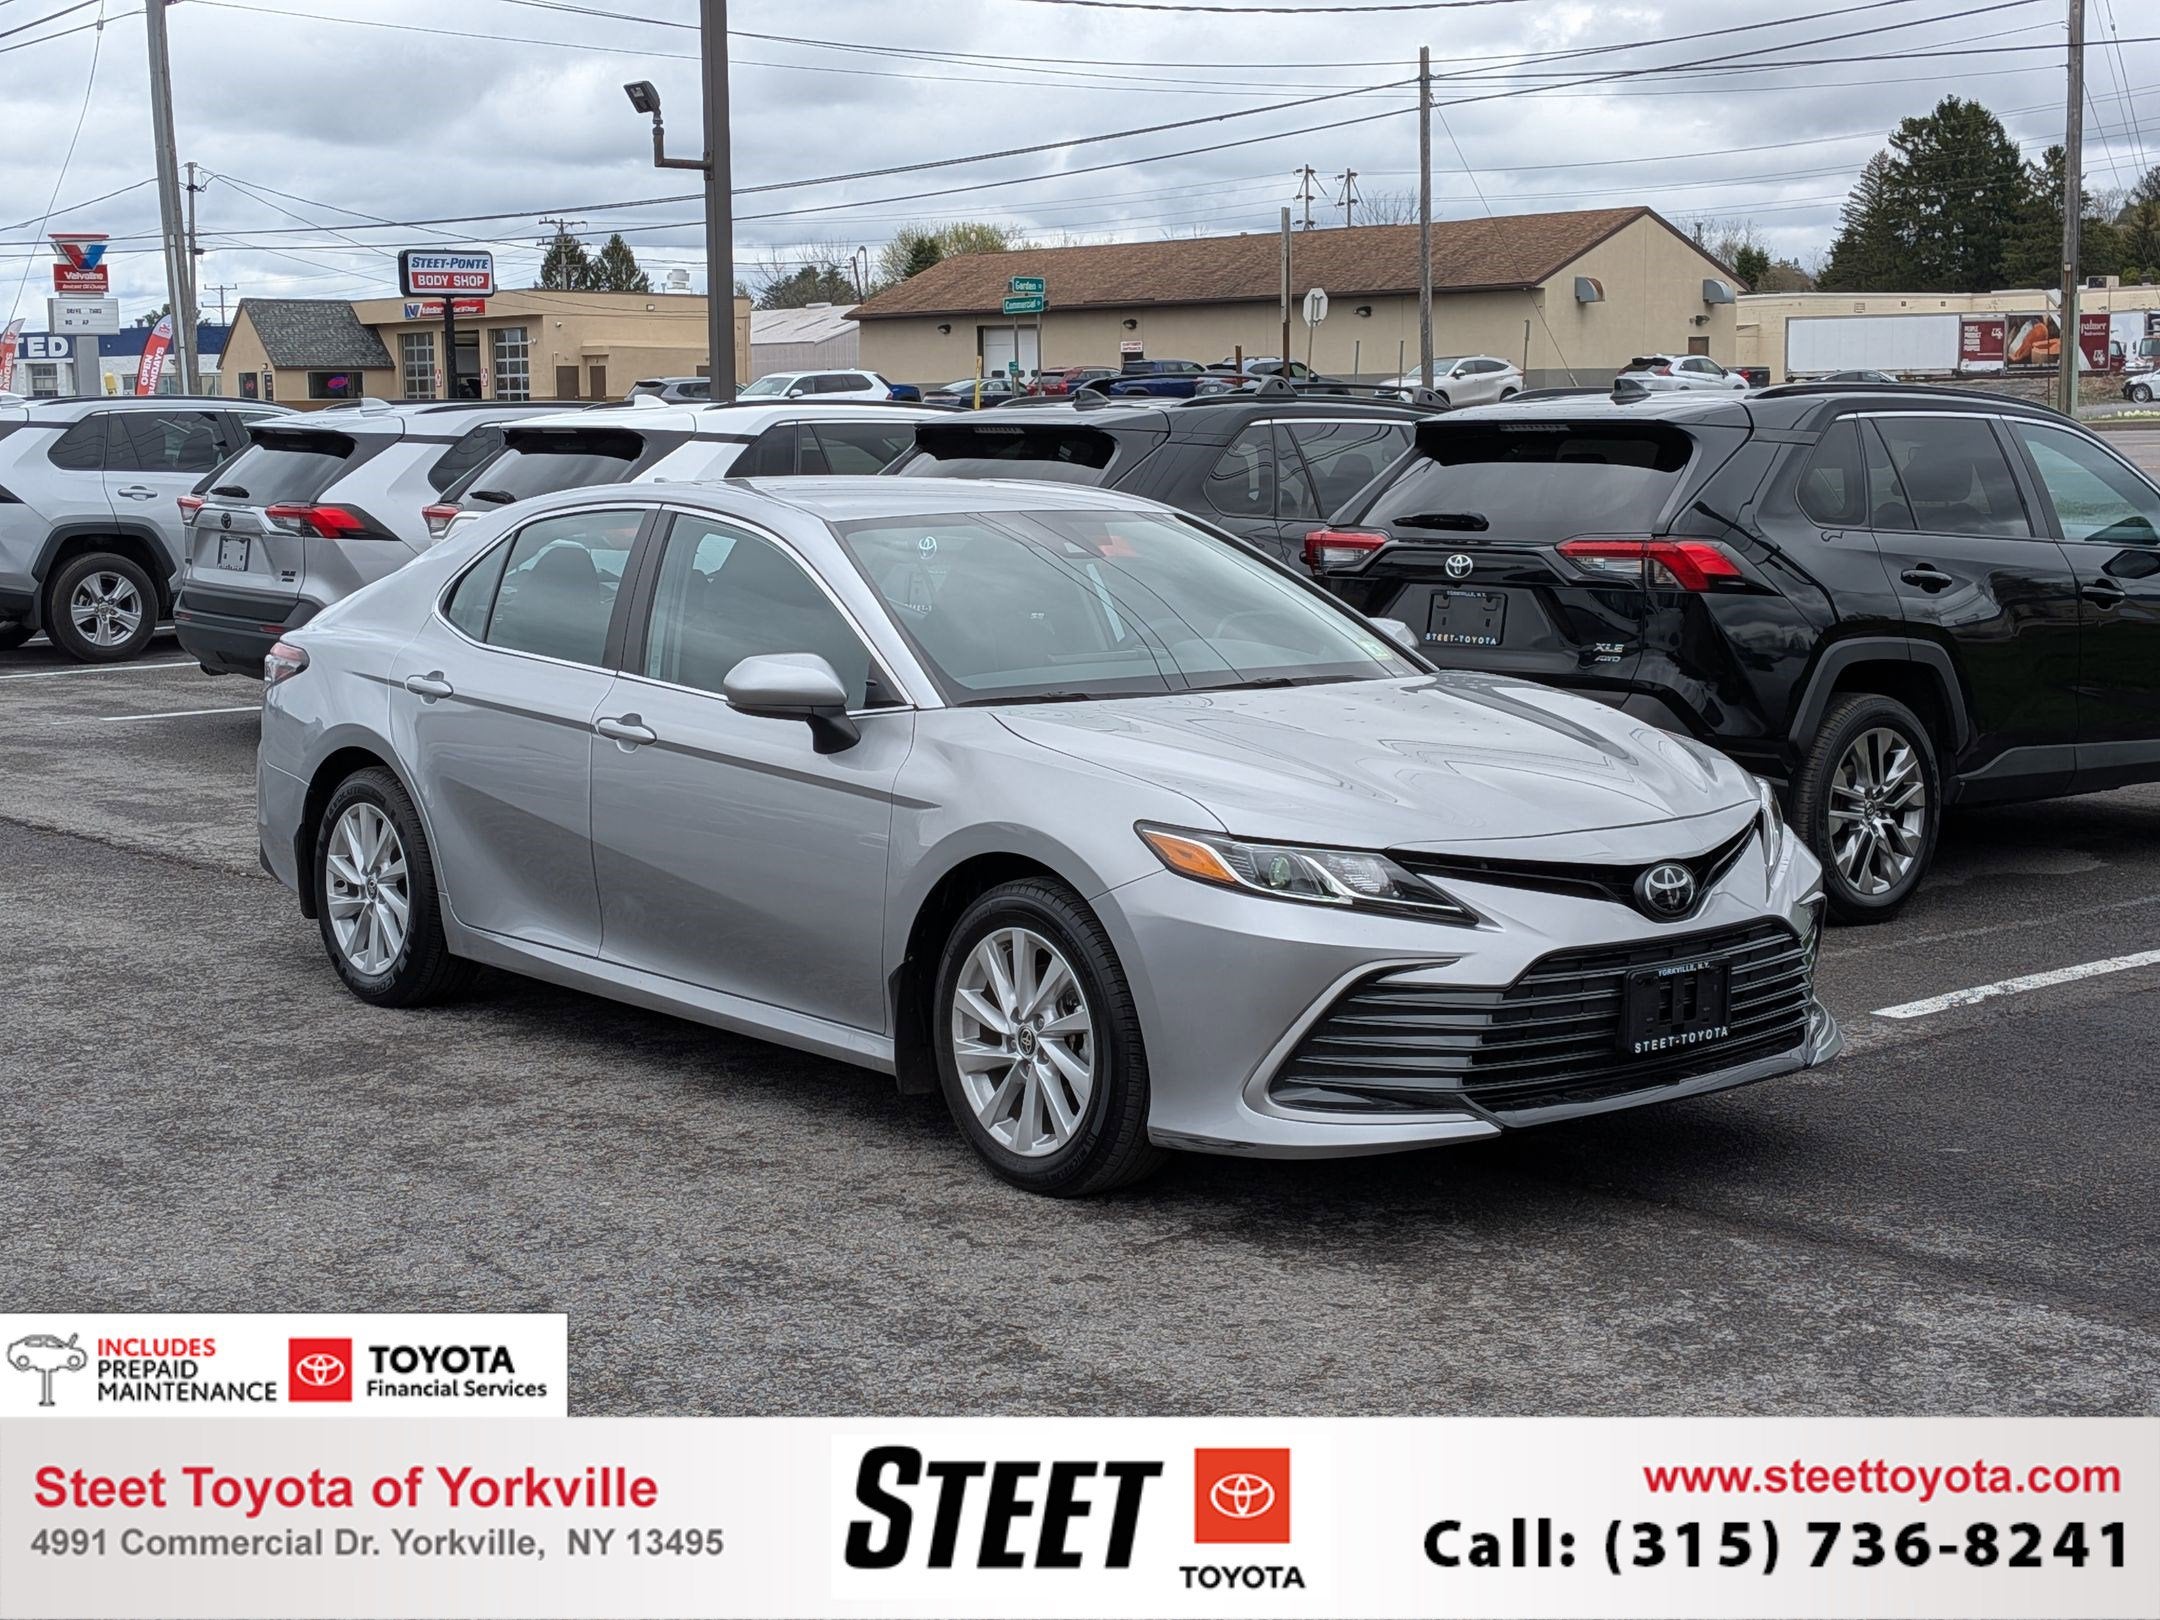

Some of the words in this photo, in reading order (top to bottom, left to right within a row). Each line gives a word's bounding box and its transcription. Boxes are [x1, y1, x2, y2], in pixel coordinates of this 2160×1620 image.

[411, 256, 489, 270] STEET-PONTE
[63, 271, 104, 280] Valvoline
[417, 274, 449, 286] BODY
[453, 275, 485, 287] SHOP
[1015, 280, 1037, 290] Garden
[1005, 299, 1037, 310] Commercial
[140, 354, 154, 387] OPEN
[1424, 633, 1497, 645] STEET-TOYOTA
[1592, 642, 1625, 653] XLE
[1634, 1026, 1729, 1054] STEET-TOYOTA
